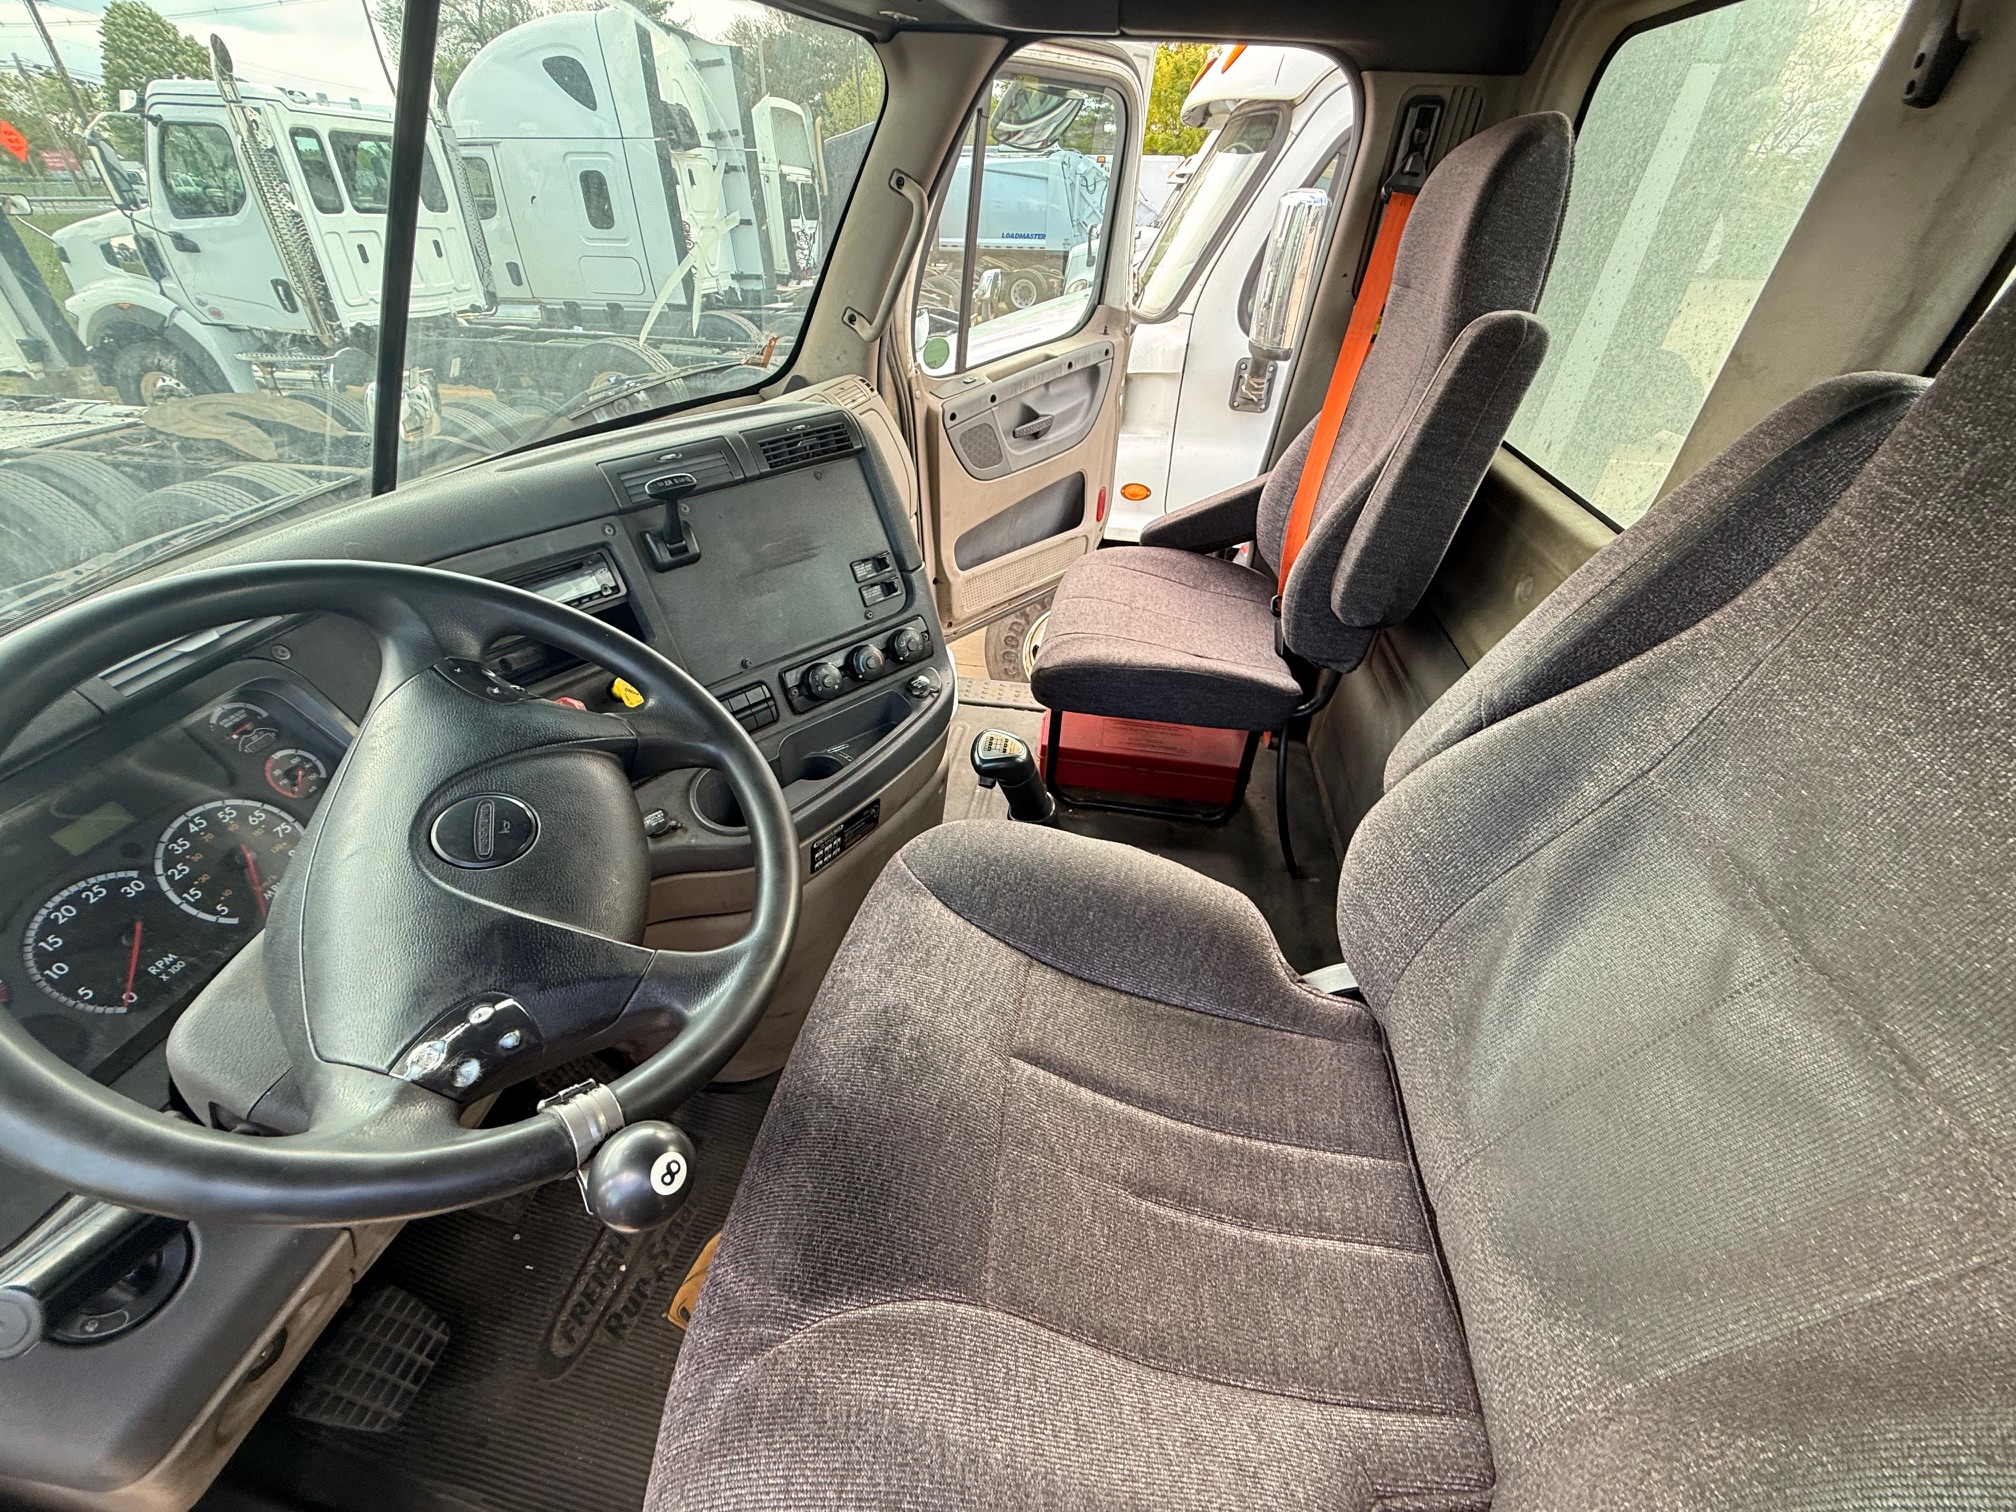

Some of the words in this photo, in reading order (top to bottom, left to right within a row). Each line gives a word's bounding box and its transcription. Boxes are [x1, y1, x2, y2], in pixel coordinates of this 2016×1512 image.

[217, 807, 236, 822] 55
[248, 810, 265, 825] 65
[188, 816, 207, 833] 45
[273, 822, 291, 838] 75
[168, 838, 190, 854] 35
[191, 852, 203, 862] 50
[168, 863, 190, 880] 25
[198, 874, 210, 883] 30
[81, 885, 107, 904] 25
[121, 880, 145, 898] 30
[182, 887, 202, 903] 15
[222, 889, 232, 898] 10
[263, 882, 280, 901] MP
[50, 905, 77, 924] 20
[216, 904, 228, 915] 5
[38, 935, 63, 952] 15
[43, 962, 69, 980] 10
[147, 953, 178, 975] RPM
[168, 960, 186, 975] 100
[77, 987, 94, 1000] 5
[660, 1159, 681, 1186] 8
